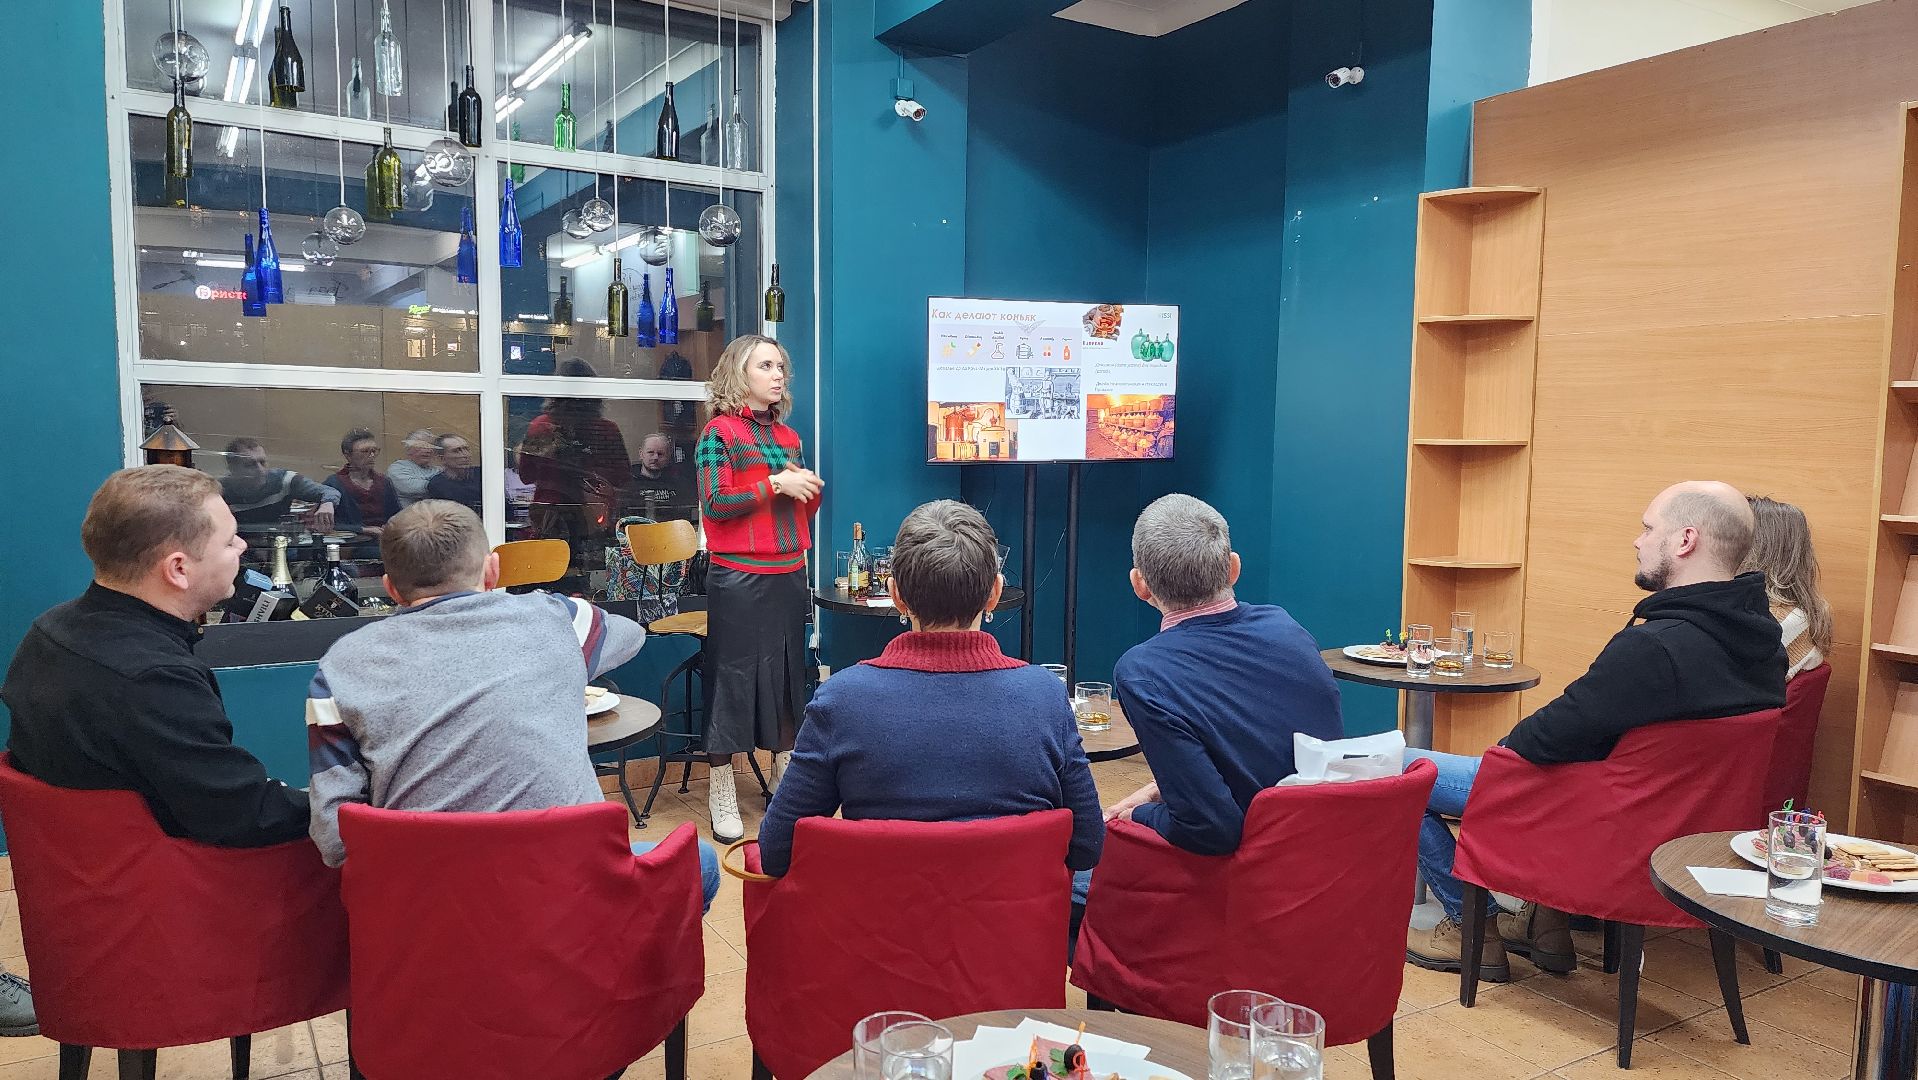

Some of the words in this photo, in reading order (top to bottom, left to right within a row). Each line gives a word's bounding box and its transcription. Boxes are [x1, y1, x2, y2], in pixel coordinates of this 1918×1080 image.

[931, 308, 952, 319] Как
[954, 311, 998, 321] делают
[1000, 312, 1037, 322] коньяк
